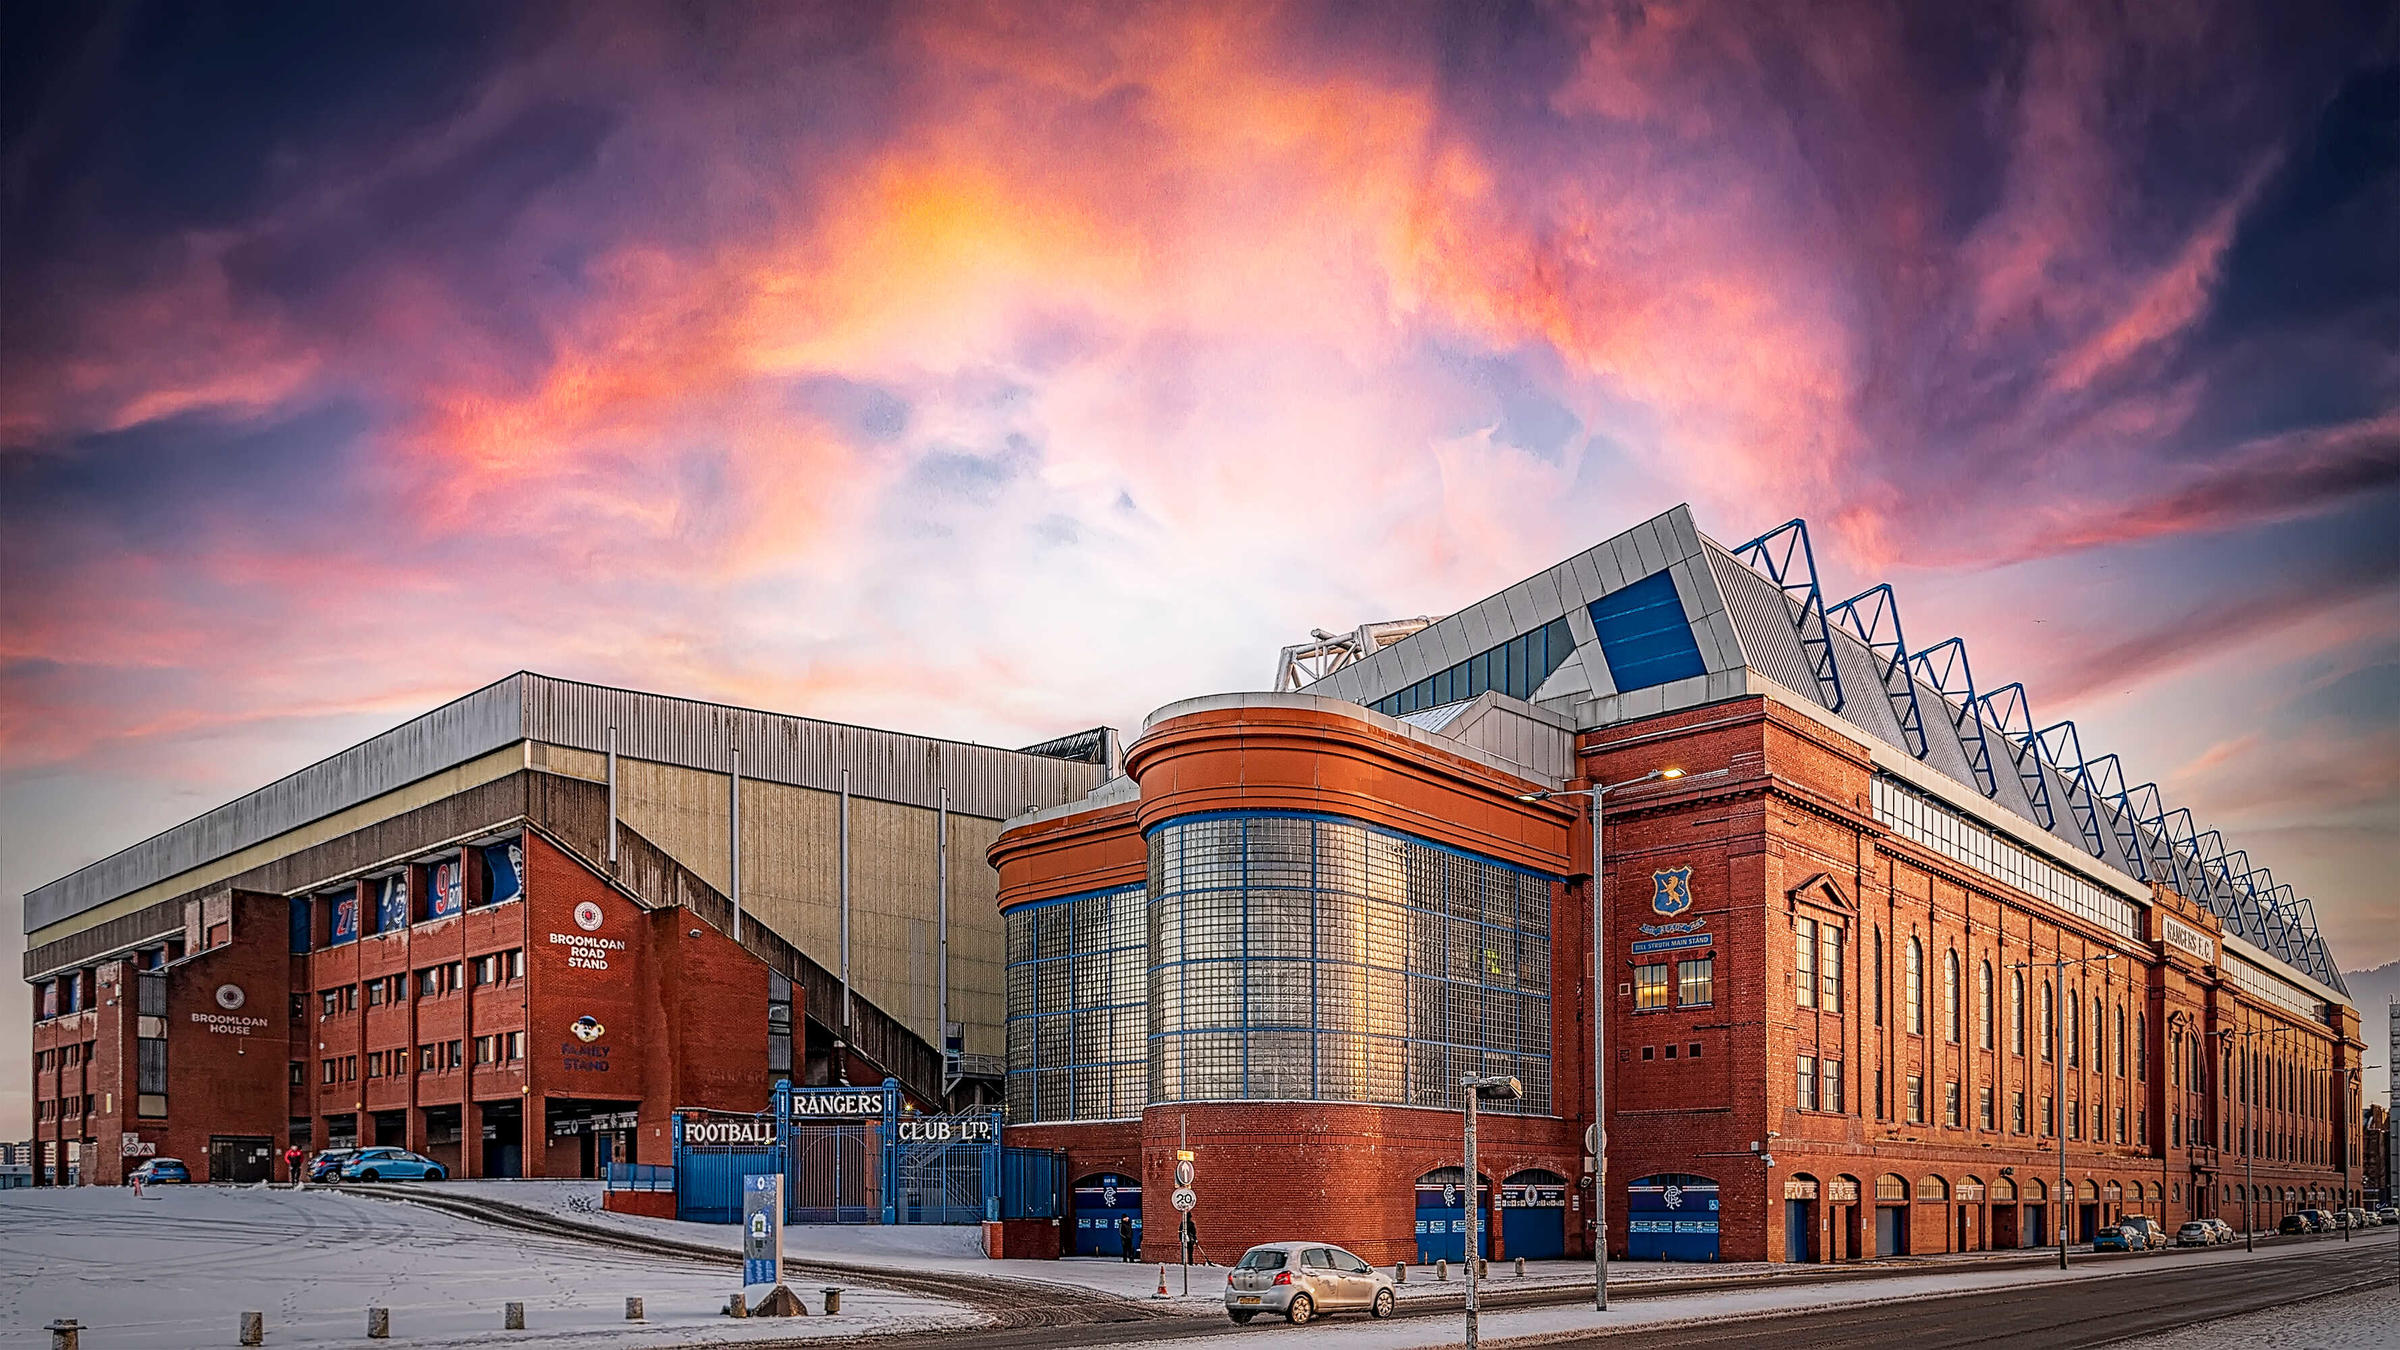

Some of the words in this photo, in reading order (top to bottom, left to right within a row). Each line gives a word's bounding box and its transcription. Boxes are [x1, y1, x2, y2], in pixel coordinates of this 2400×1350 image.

[436, 864, 449, 914] 9
[549, 933, 625, 950] BROOMLOAN
[1688, 937, 1709, 945] STAND
[571, 946, 606, 959] ROAD
[568, 957, 608, 970] STAND
[191, 1013, 268, 1027] BROOMLOAN
[210, 1024, 251, 1035] HOUSE
[794, 1095, 883, 1115] RANGERS
[685, 1123, 777, 1143] FOOTBALL
[899, 1122, 951, 1140] CLUB
[1176, 1194, 1193, 1205] 20
